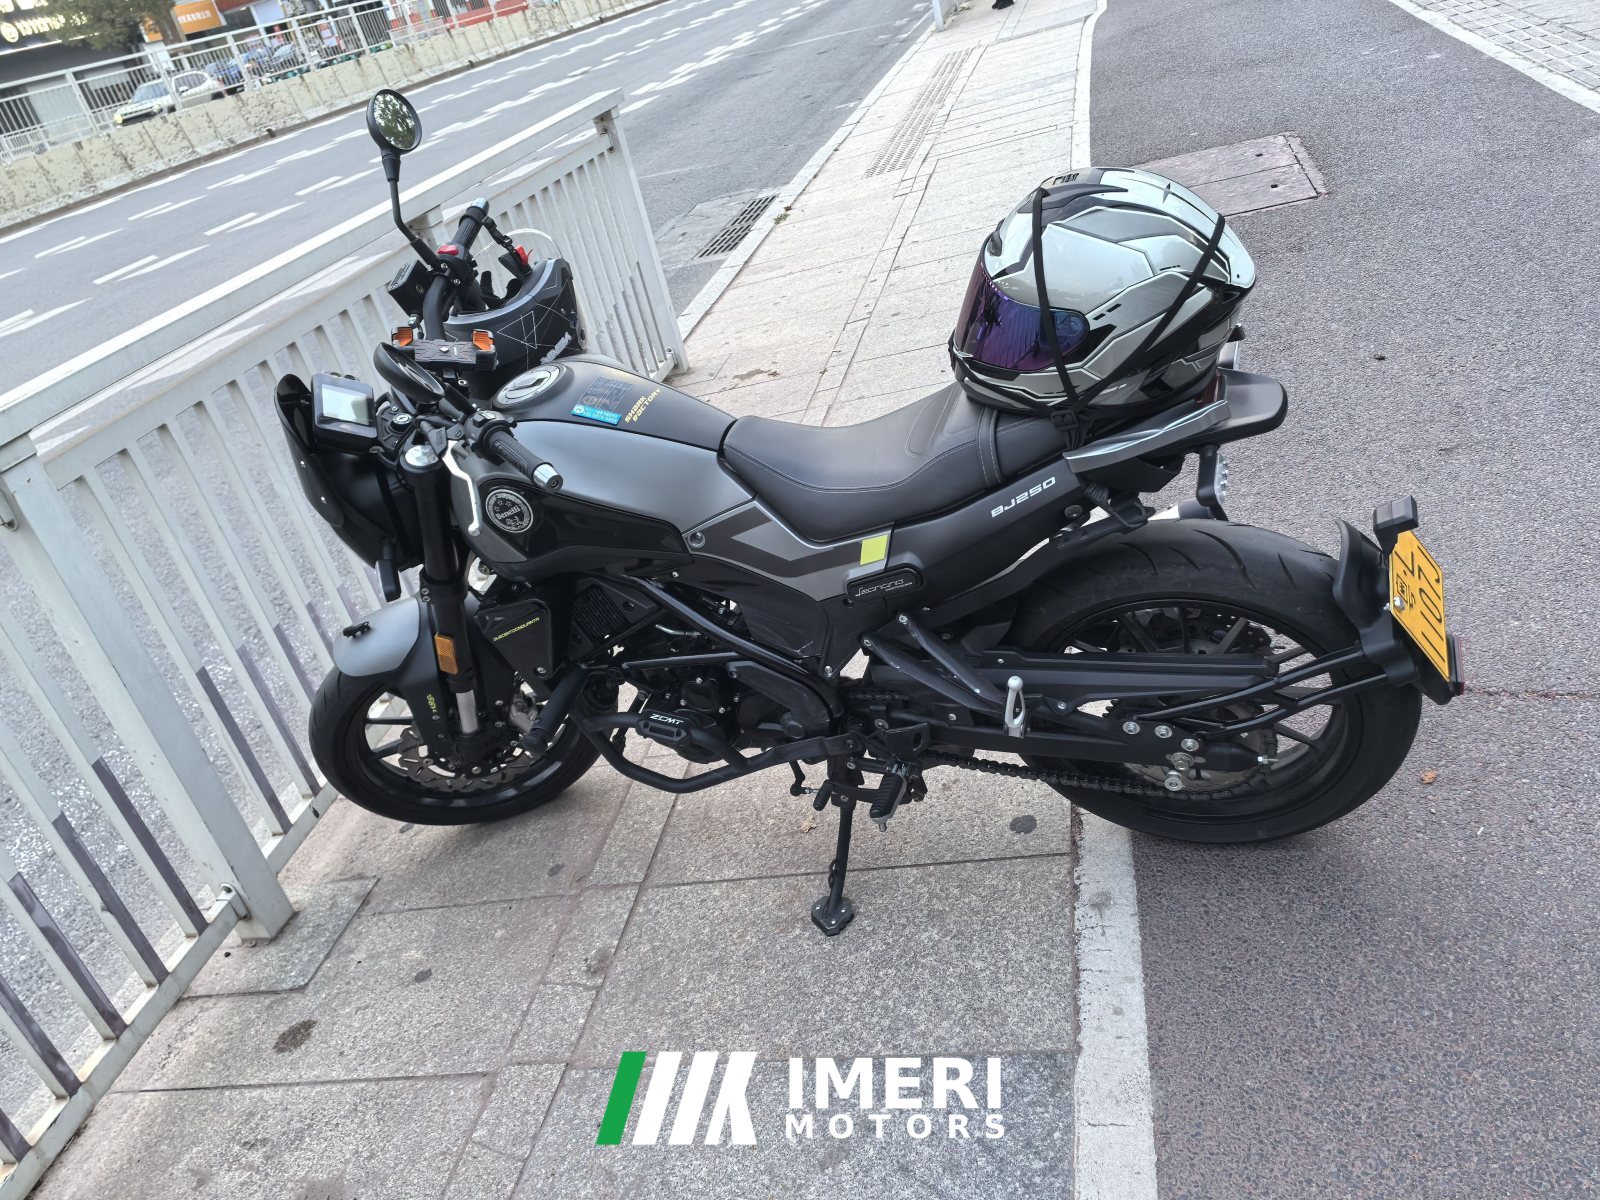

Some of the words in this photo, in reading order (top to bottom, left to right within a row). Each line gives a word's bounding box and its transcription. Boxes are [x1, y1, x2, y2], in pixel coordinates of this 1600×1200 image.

[991, 476, 1056, 518] BJ250
[494, 505, 521, 520] Benelli
[649, 713, 685, 725] ZCMT
